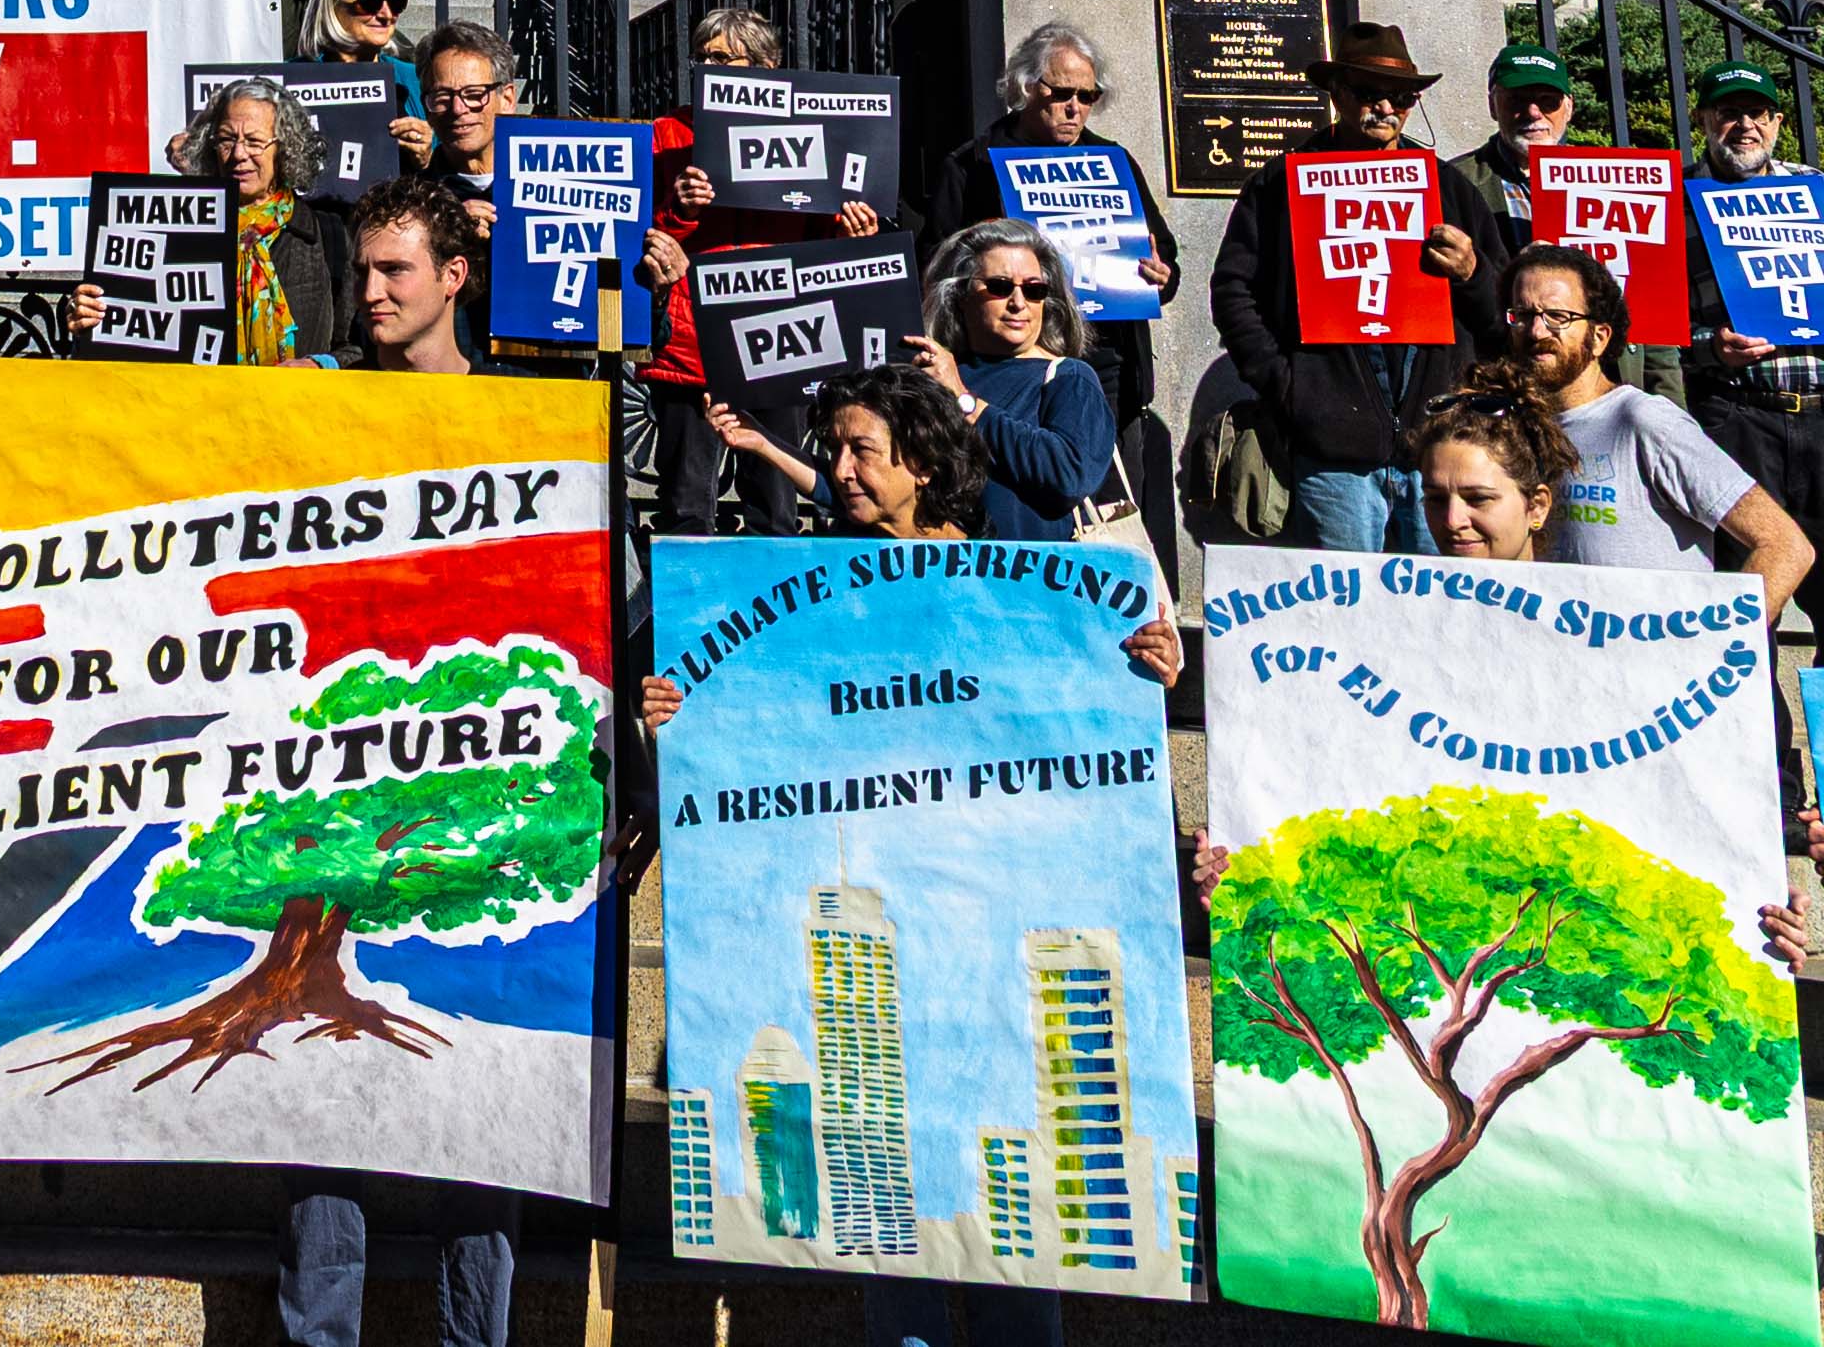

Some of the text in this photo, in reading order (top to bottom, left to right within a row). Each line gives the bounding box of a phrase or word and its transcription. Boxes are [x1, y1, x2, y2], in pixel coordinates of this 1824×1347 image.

[1210, 33, 1246, 44] Monday
[1213, 58, 1285, 69] Public Welcome
[709, 83, 888, 112] MAKE POLLUTERS
[346, 150, 355, 171] !
[518, 143, 624, 173] MAKE
[739, 136, 814, 170] PAY
[849, 161, 860, 183] !
[1015, 160, 1110, 185] MAKE
[1306, 165, 1419, 188] POLLUTERS
[1549, 165, 1663, 185] POLLUTERS
[116, 195, 217, 225] MAKE
[521, 182, 632, 214] POLLUTERS
[1027, 191, 1124, 210] POLLUTERS
[1712, 191, 1810, 218] MAKE
[1335, 198, 1415, 232] PAY
[1576, 196, 1657, 236] PAY
[534, 221, 606, 255] PAY
[1726, 225, 1824, 245] POLLUTERS
[104, 234, 156, 270] BIG
[1329, 241, 1378, 271] UP
[1747, 252, 1811, 281] PAY
[166, 271, 215, 302] OIL
[563, 266, 580, 299] !
[704, 259, 903, 297] MAKE POLLUTERS
[1367, 279, 1380, 307] !
[1788, 289, 1800, 314] !
[101, 307, 174, 341] PAY
[203, 334, 217, 362] !
[744, 314, 826, 366] PAY
[870, 337, 879, 362] !
[411, 468, 562, 541] PAY
[848, 542, 1149, 619] SUPERFUND
[1203, 556, 1763, 649] Shady Green Spaces
[145, 618, 301, 687] OUR
[829, 667, 980, 716] Builds
[1249, 638, 1758, 775] for EJ Communities
[221, 701, 545, 800] FUTURE
[674, 746, 1156, 827] A RESILIENT FUTURE
